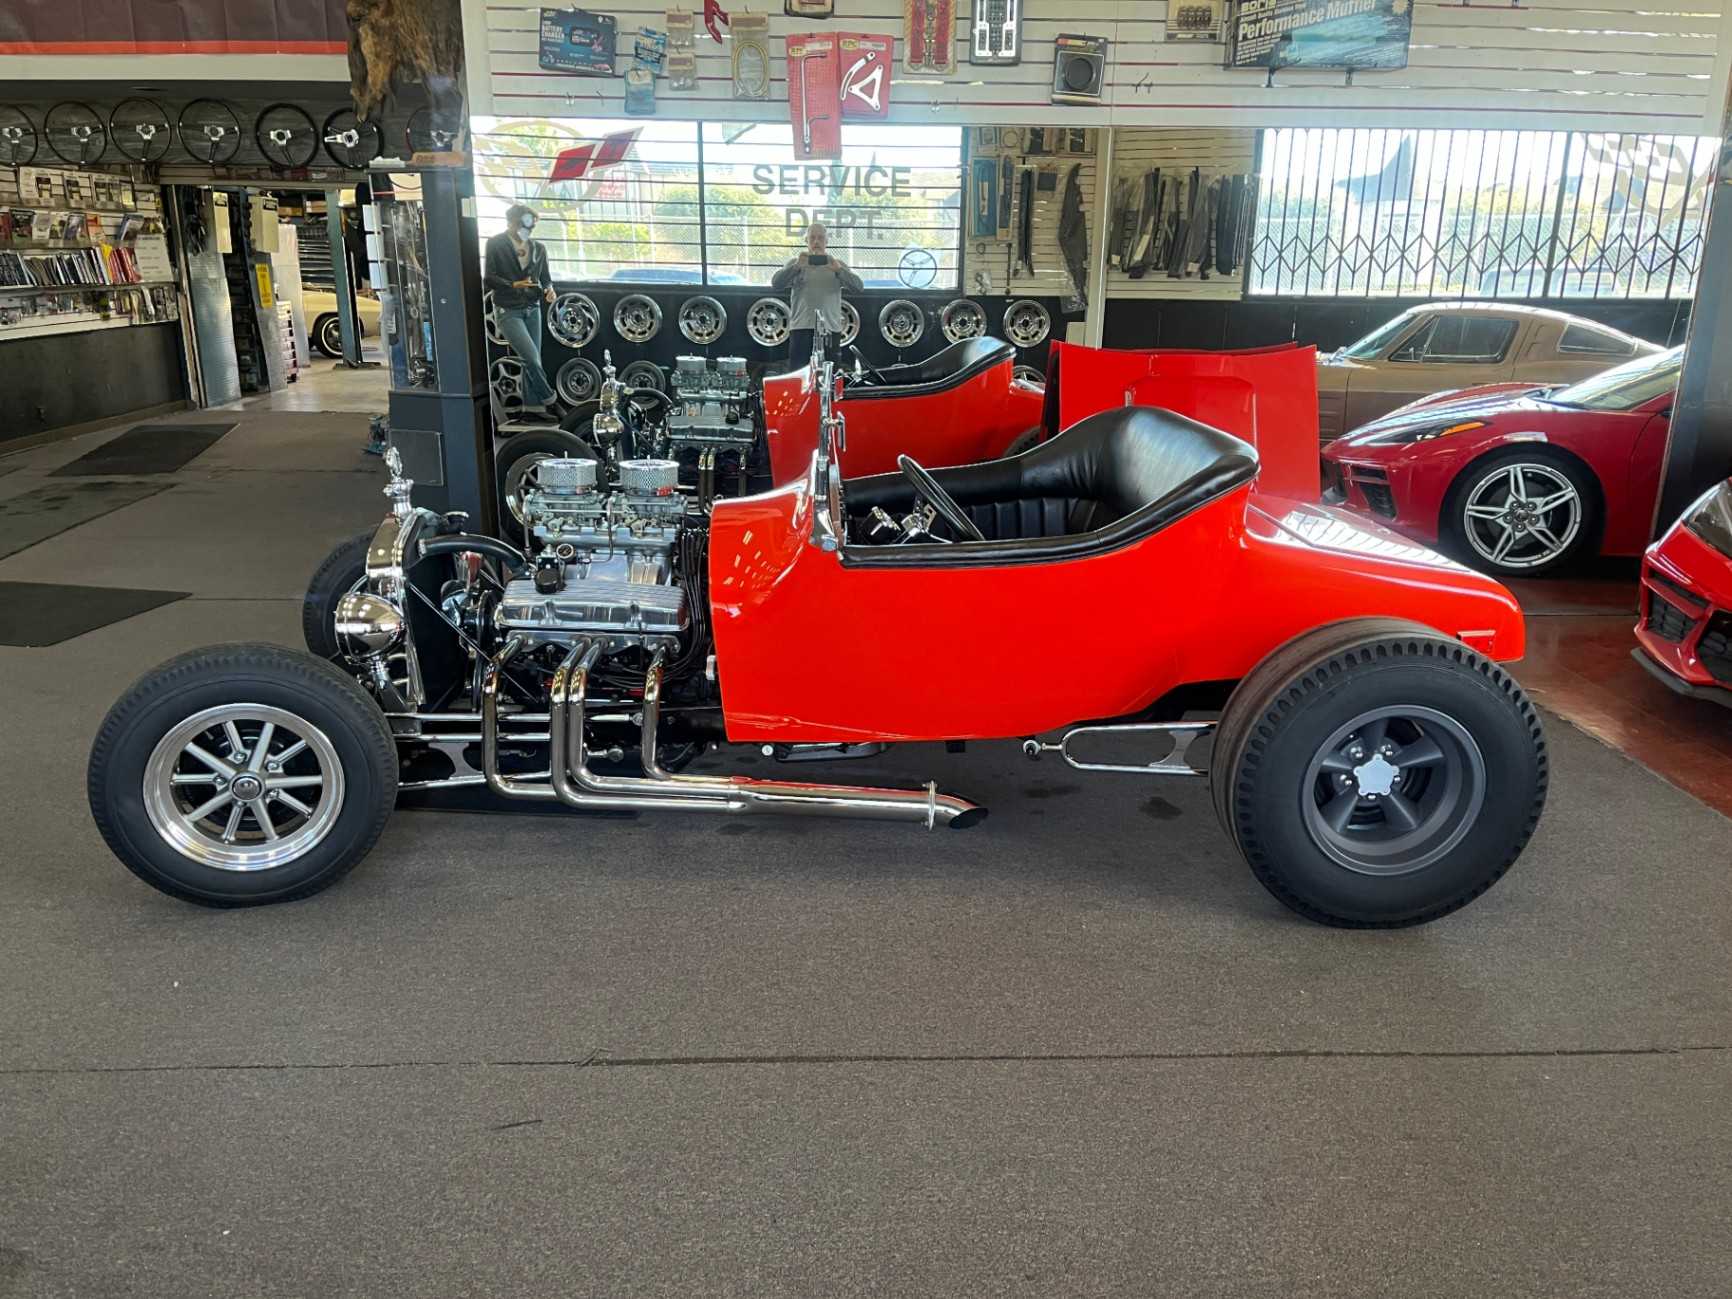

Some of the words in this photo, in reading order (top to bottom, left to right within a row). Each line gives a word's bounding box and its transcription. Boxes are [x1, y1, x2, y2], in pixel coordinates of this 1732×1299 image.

[1238, 7, 1325, 41] Performance
[753, 164, 912, 197] SERVICE
[785, 208, 883, 240] DEPT.
